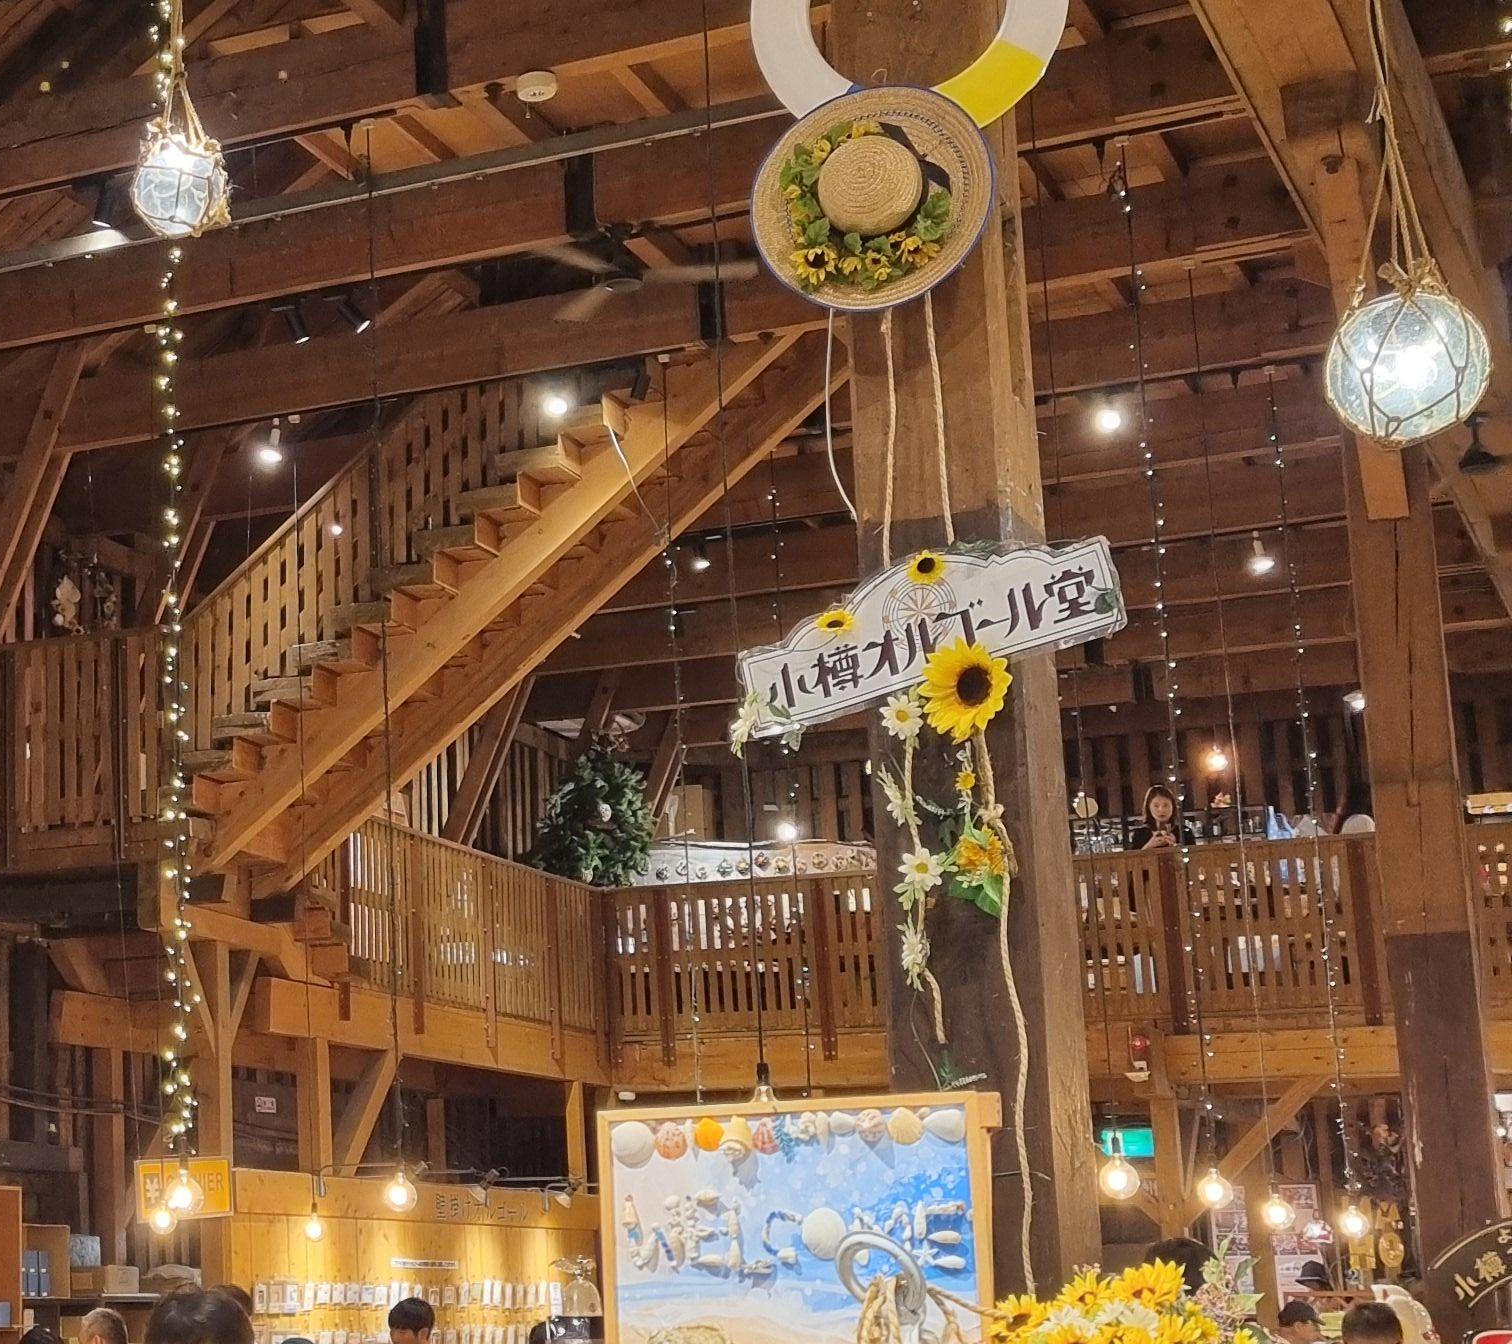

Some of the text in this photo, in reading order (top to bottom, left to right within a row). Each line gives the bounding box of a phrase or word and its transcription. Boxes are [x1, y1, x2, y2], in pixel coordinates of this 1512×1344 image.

[768, 565, 1096, 708] 小樽オルゴール堂
